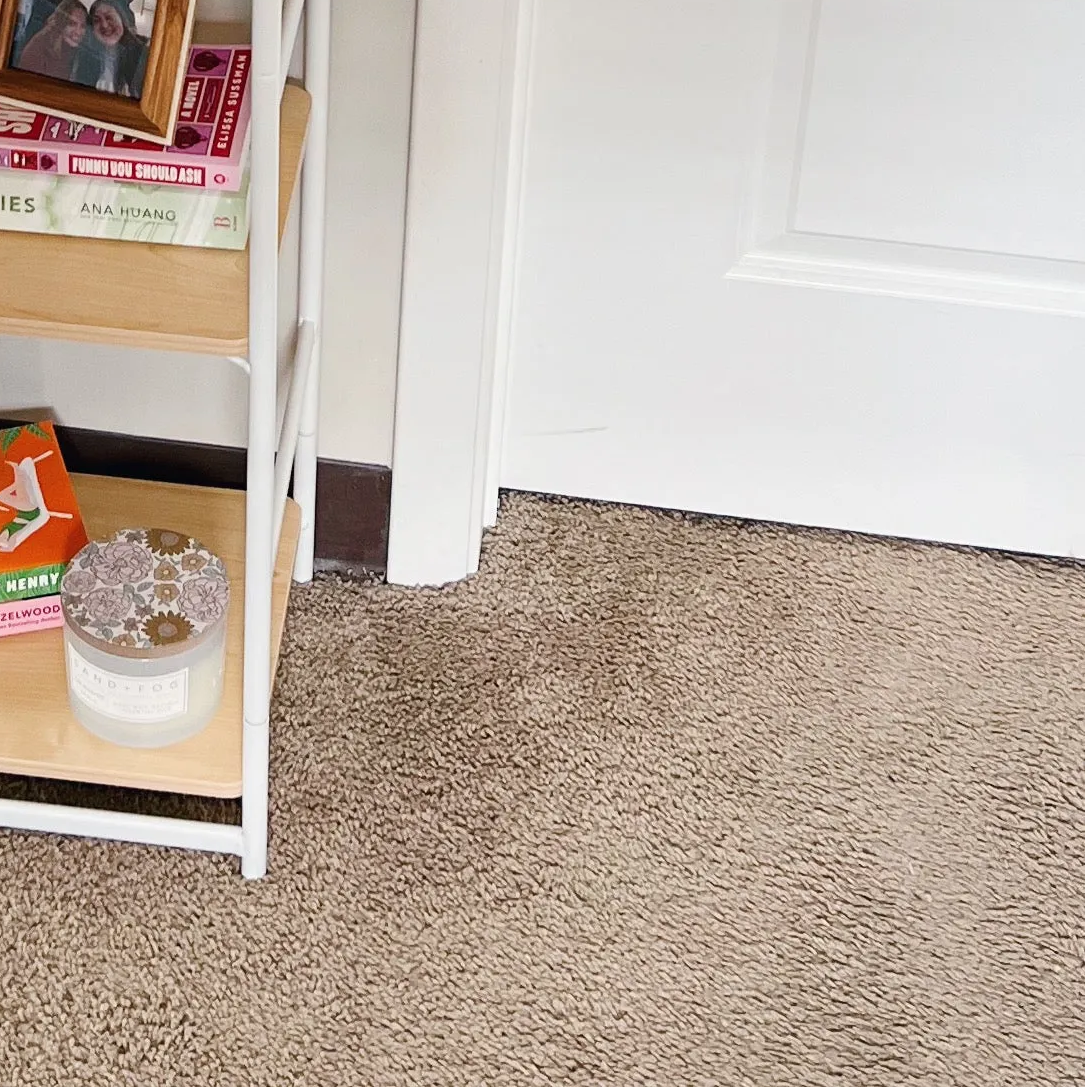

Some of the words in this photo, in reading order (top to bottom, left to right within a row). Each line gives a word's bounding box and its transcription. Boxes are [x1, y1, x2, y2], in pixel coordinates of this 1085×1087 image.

[183, 80, 200, 109] NOVEL
[217, 109, 234, 149] ELISSA
[227, 54, 247, 105] SUSSMAN
[72, 157, 109, 175] FUNNY
[110, 161, 132, 177] YOU
[135, 163, 178, 183] SHOULD
[178, 167, 202, 185] ASK
[81, 202, 114, 216] ANA
[120, 205, 177, 221] HUANG
[6, 572, 60, 593] HENRY
[138, 680, 179, 693] FOG
